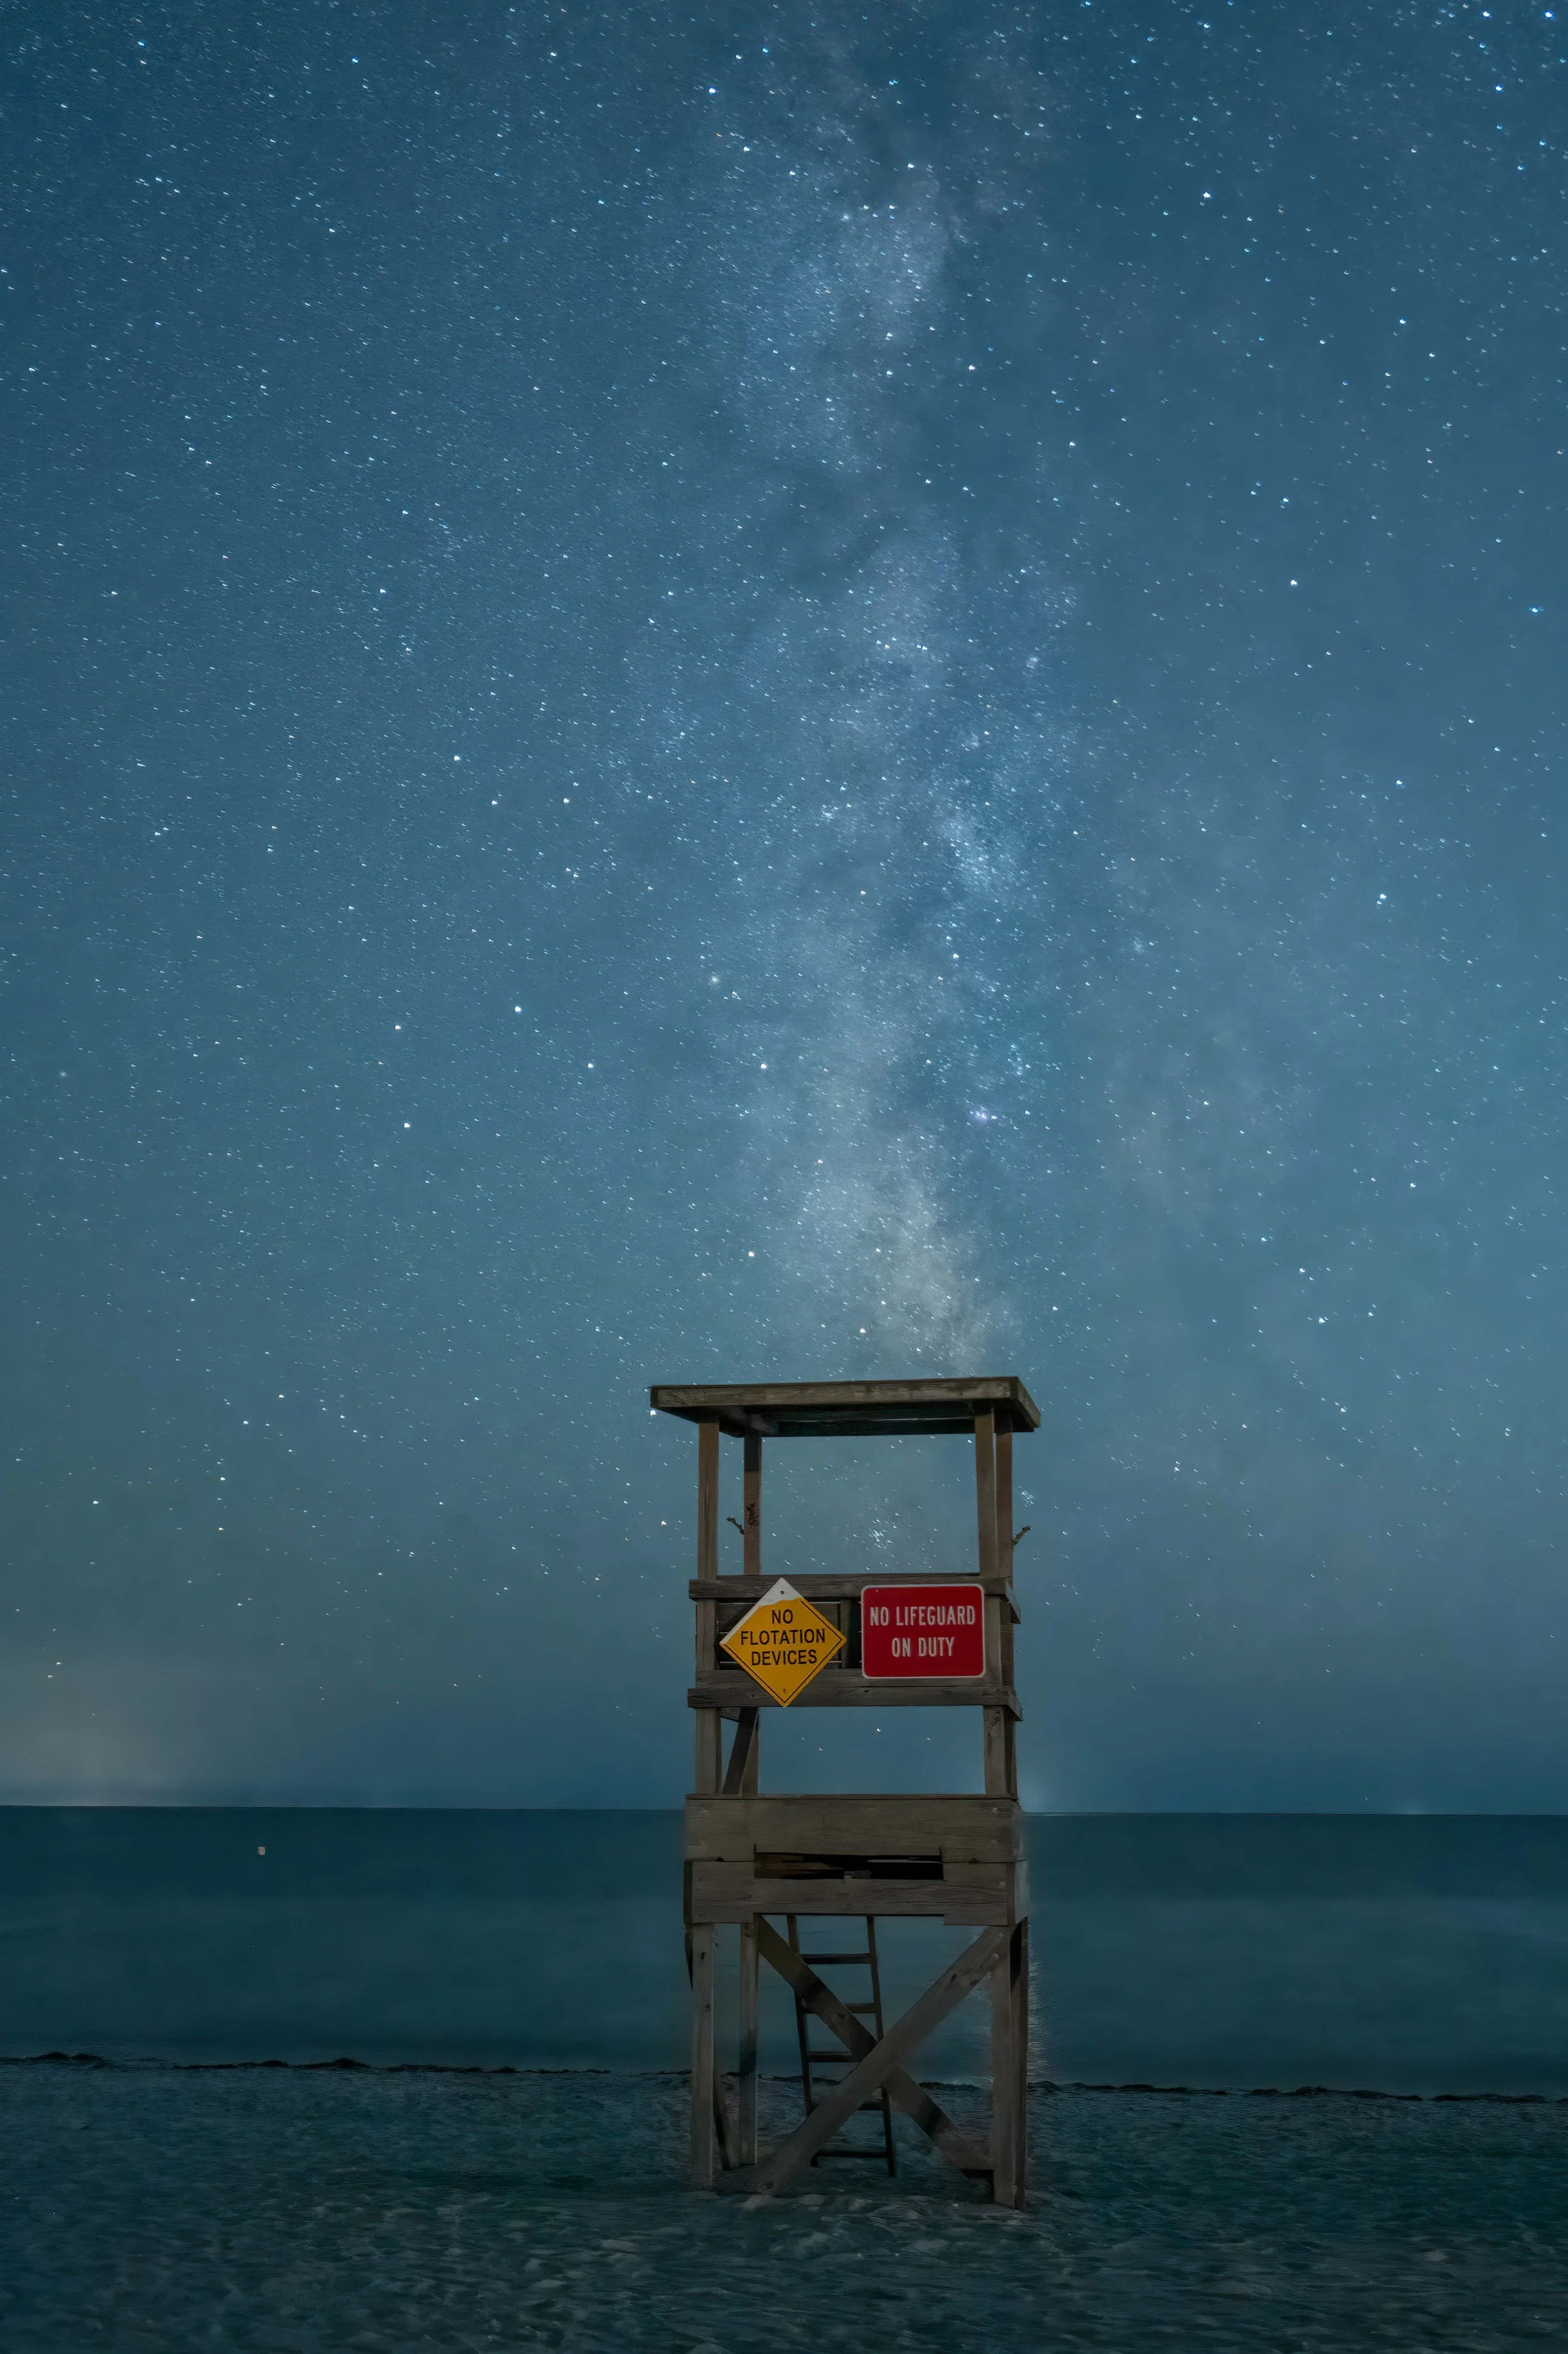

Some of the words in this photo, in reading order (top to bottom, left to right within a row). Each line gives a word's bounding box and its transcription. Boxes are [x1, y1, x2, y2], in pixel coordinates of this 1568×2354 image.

[771, 1609, 793, 1624] NO
[869, 1606, 889, 1626] NO
[896, 1605, 975, 1626] LIFEGUARD
[741, 1627, 826, 1646] FLOTATION
[891, 1637, 911, 1658] ON
[918, 1636, 955, 1657] DUTY
[751, 1649, 817, 1666] DEVICES
